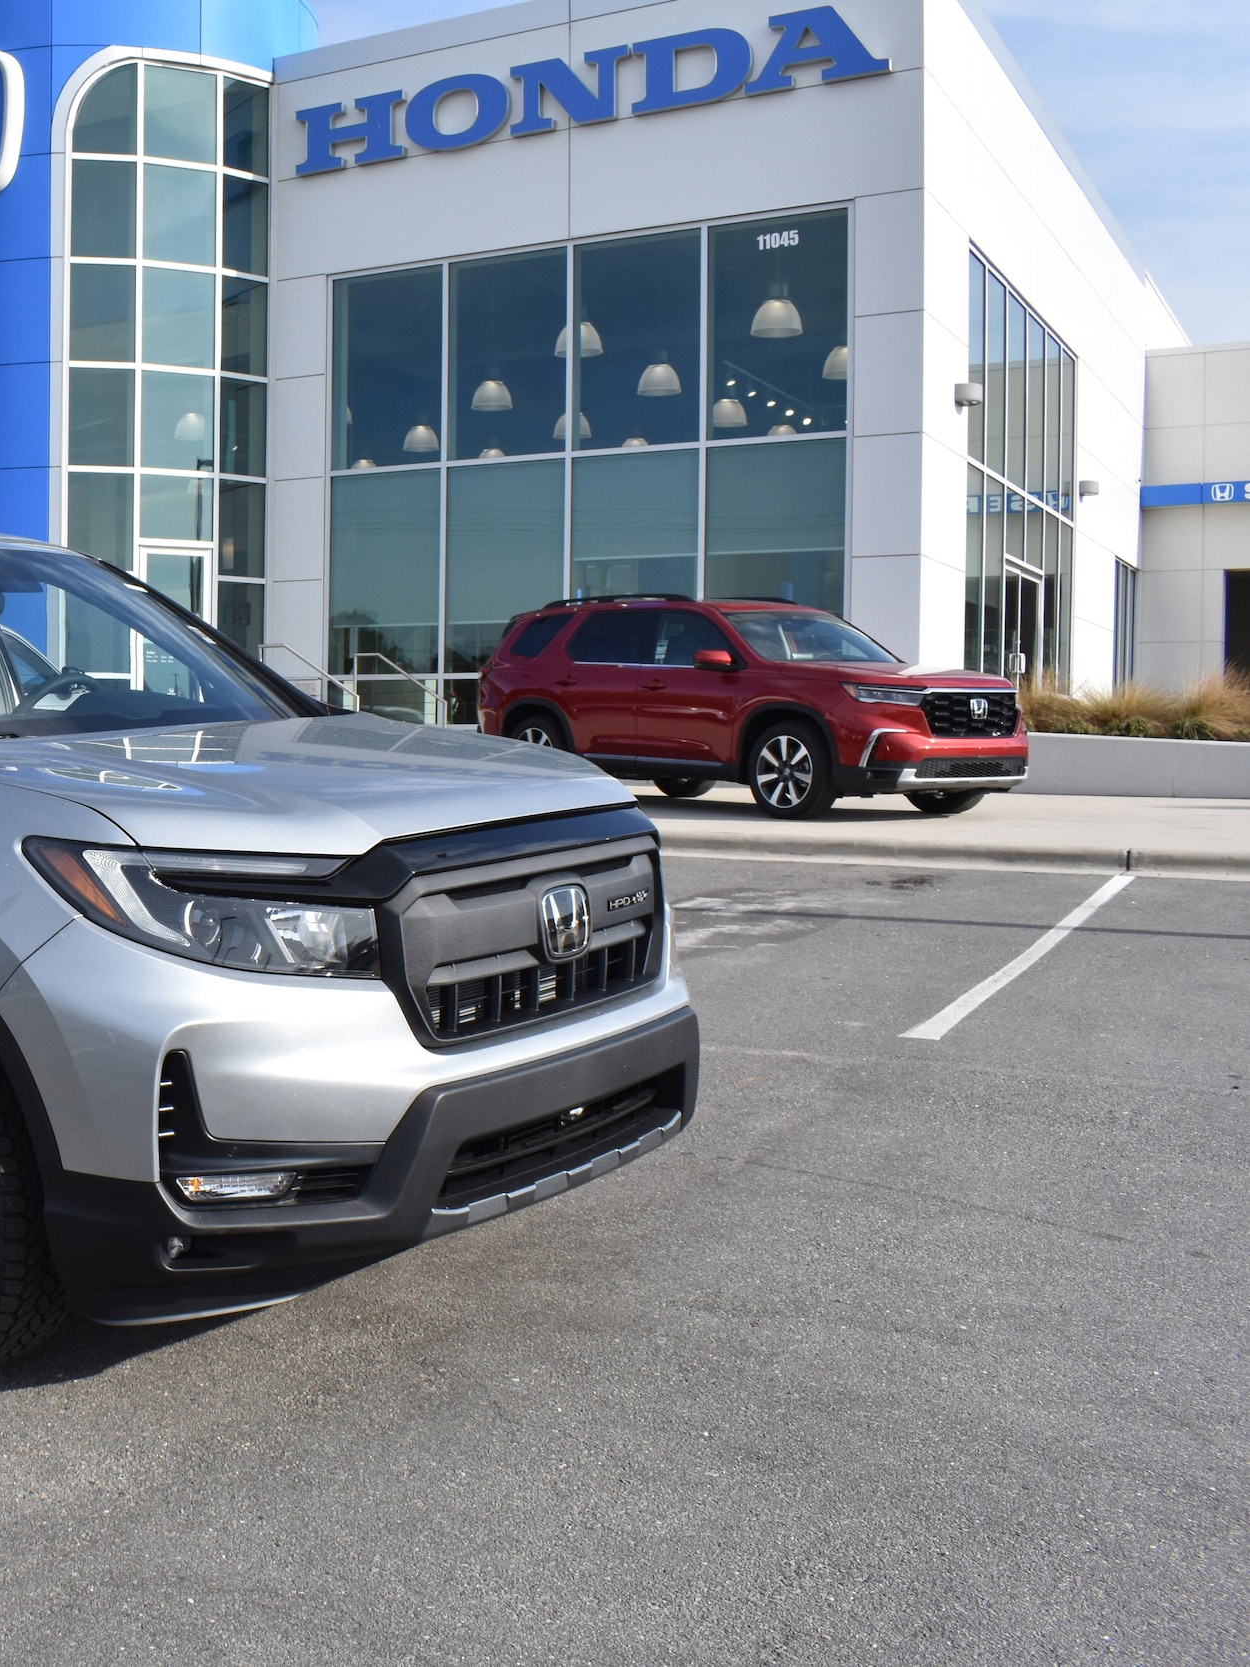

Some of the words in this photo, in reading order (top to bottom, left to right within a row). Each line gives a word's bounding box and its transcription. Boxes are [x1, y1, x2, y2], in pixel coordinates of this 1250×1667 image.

[295, 5, 892, 176] HONDA
[756, 229, 799, 250] 11045
[609, 896, 631, 911] HPD
